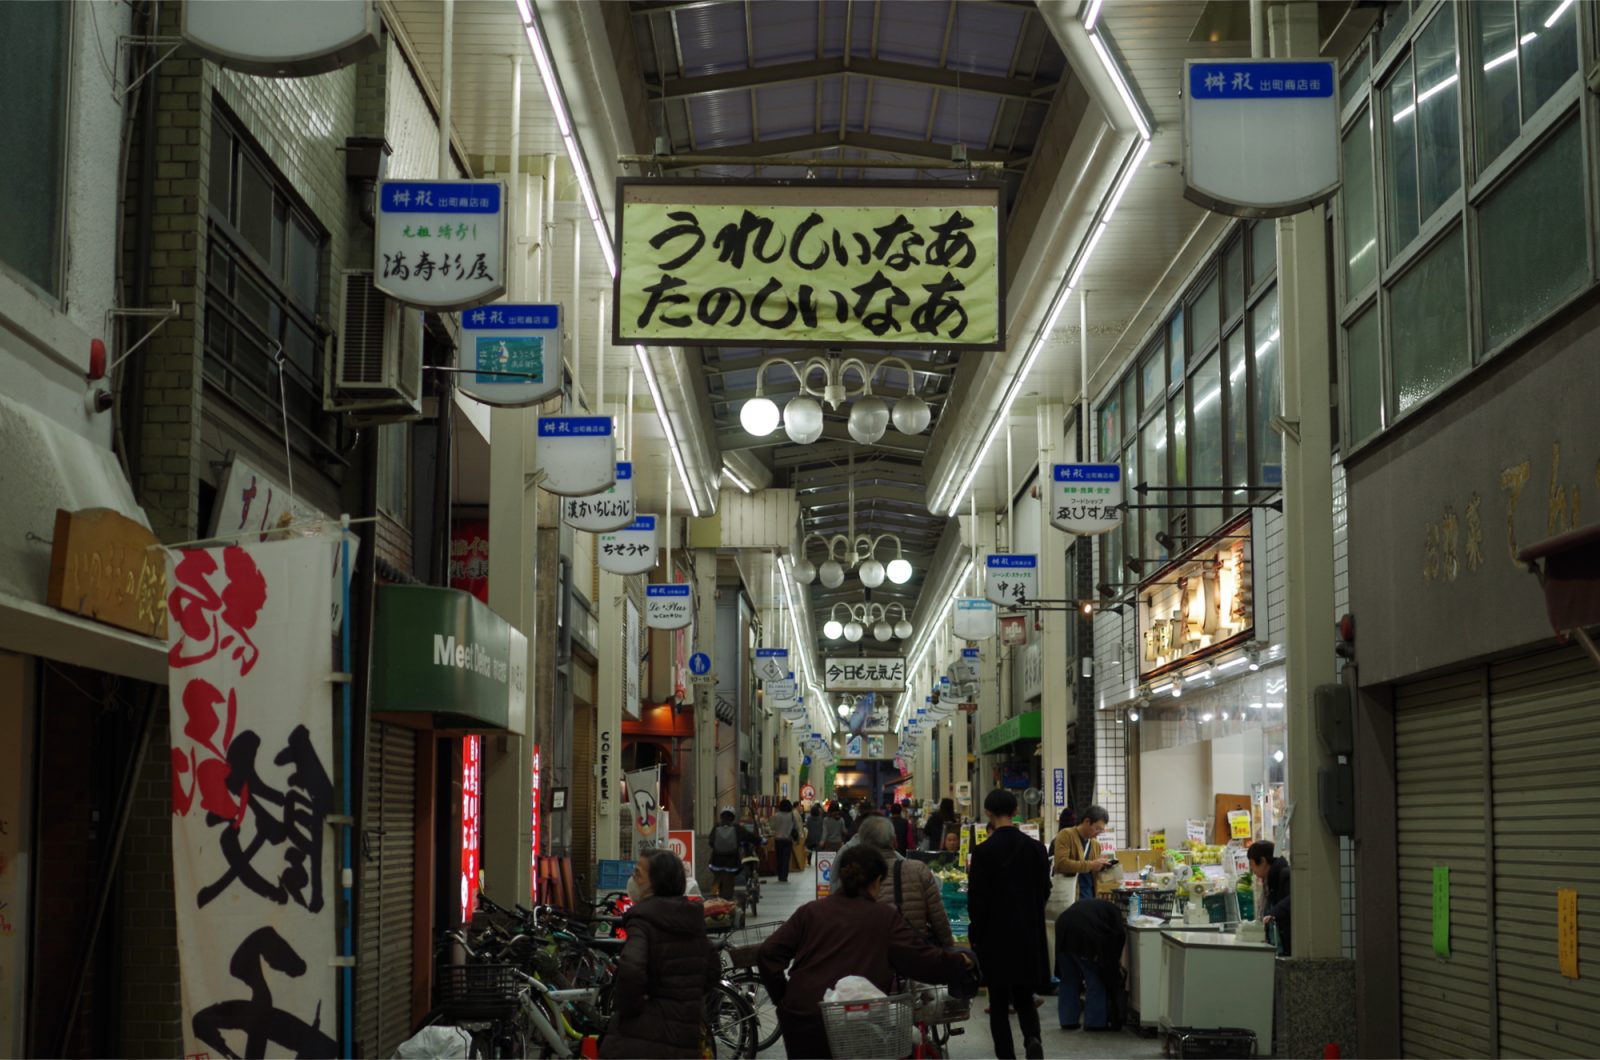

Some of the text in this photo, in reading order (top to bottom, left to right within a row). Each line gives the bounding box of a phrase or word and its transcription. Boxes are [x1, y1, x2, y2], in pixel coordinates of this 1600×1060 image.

[1260, 79, 1321, 91] 出町商店街
[438, 197, 489, 208] 出町商店街
[648, 209, 977, 271] うれしいなあ
[636, 270, 969, 340] たのしいなあ
[568, 500, 630, 518] 漢方いちじょうじ
[603, 543, 650, 556] ちそうや
[827, 662, 904, 682] 今日も元気だ
[601, 731, 610, 800] COFFEE
